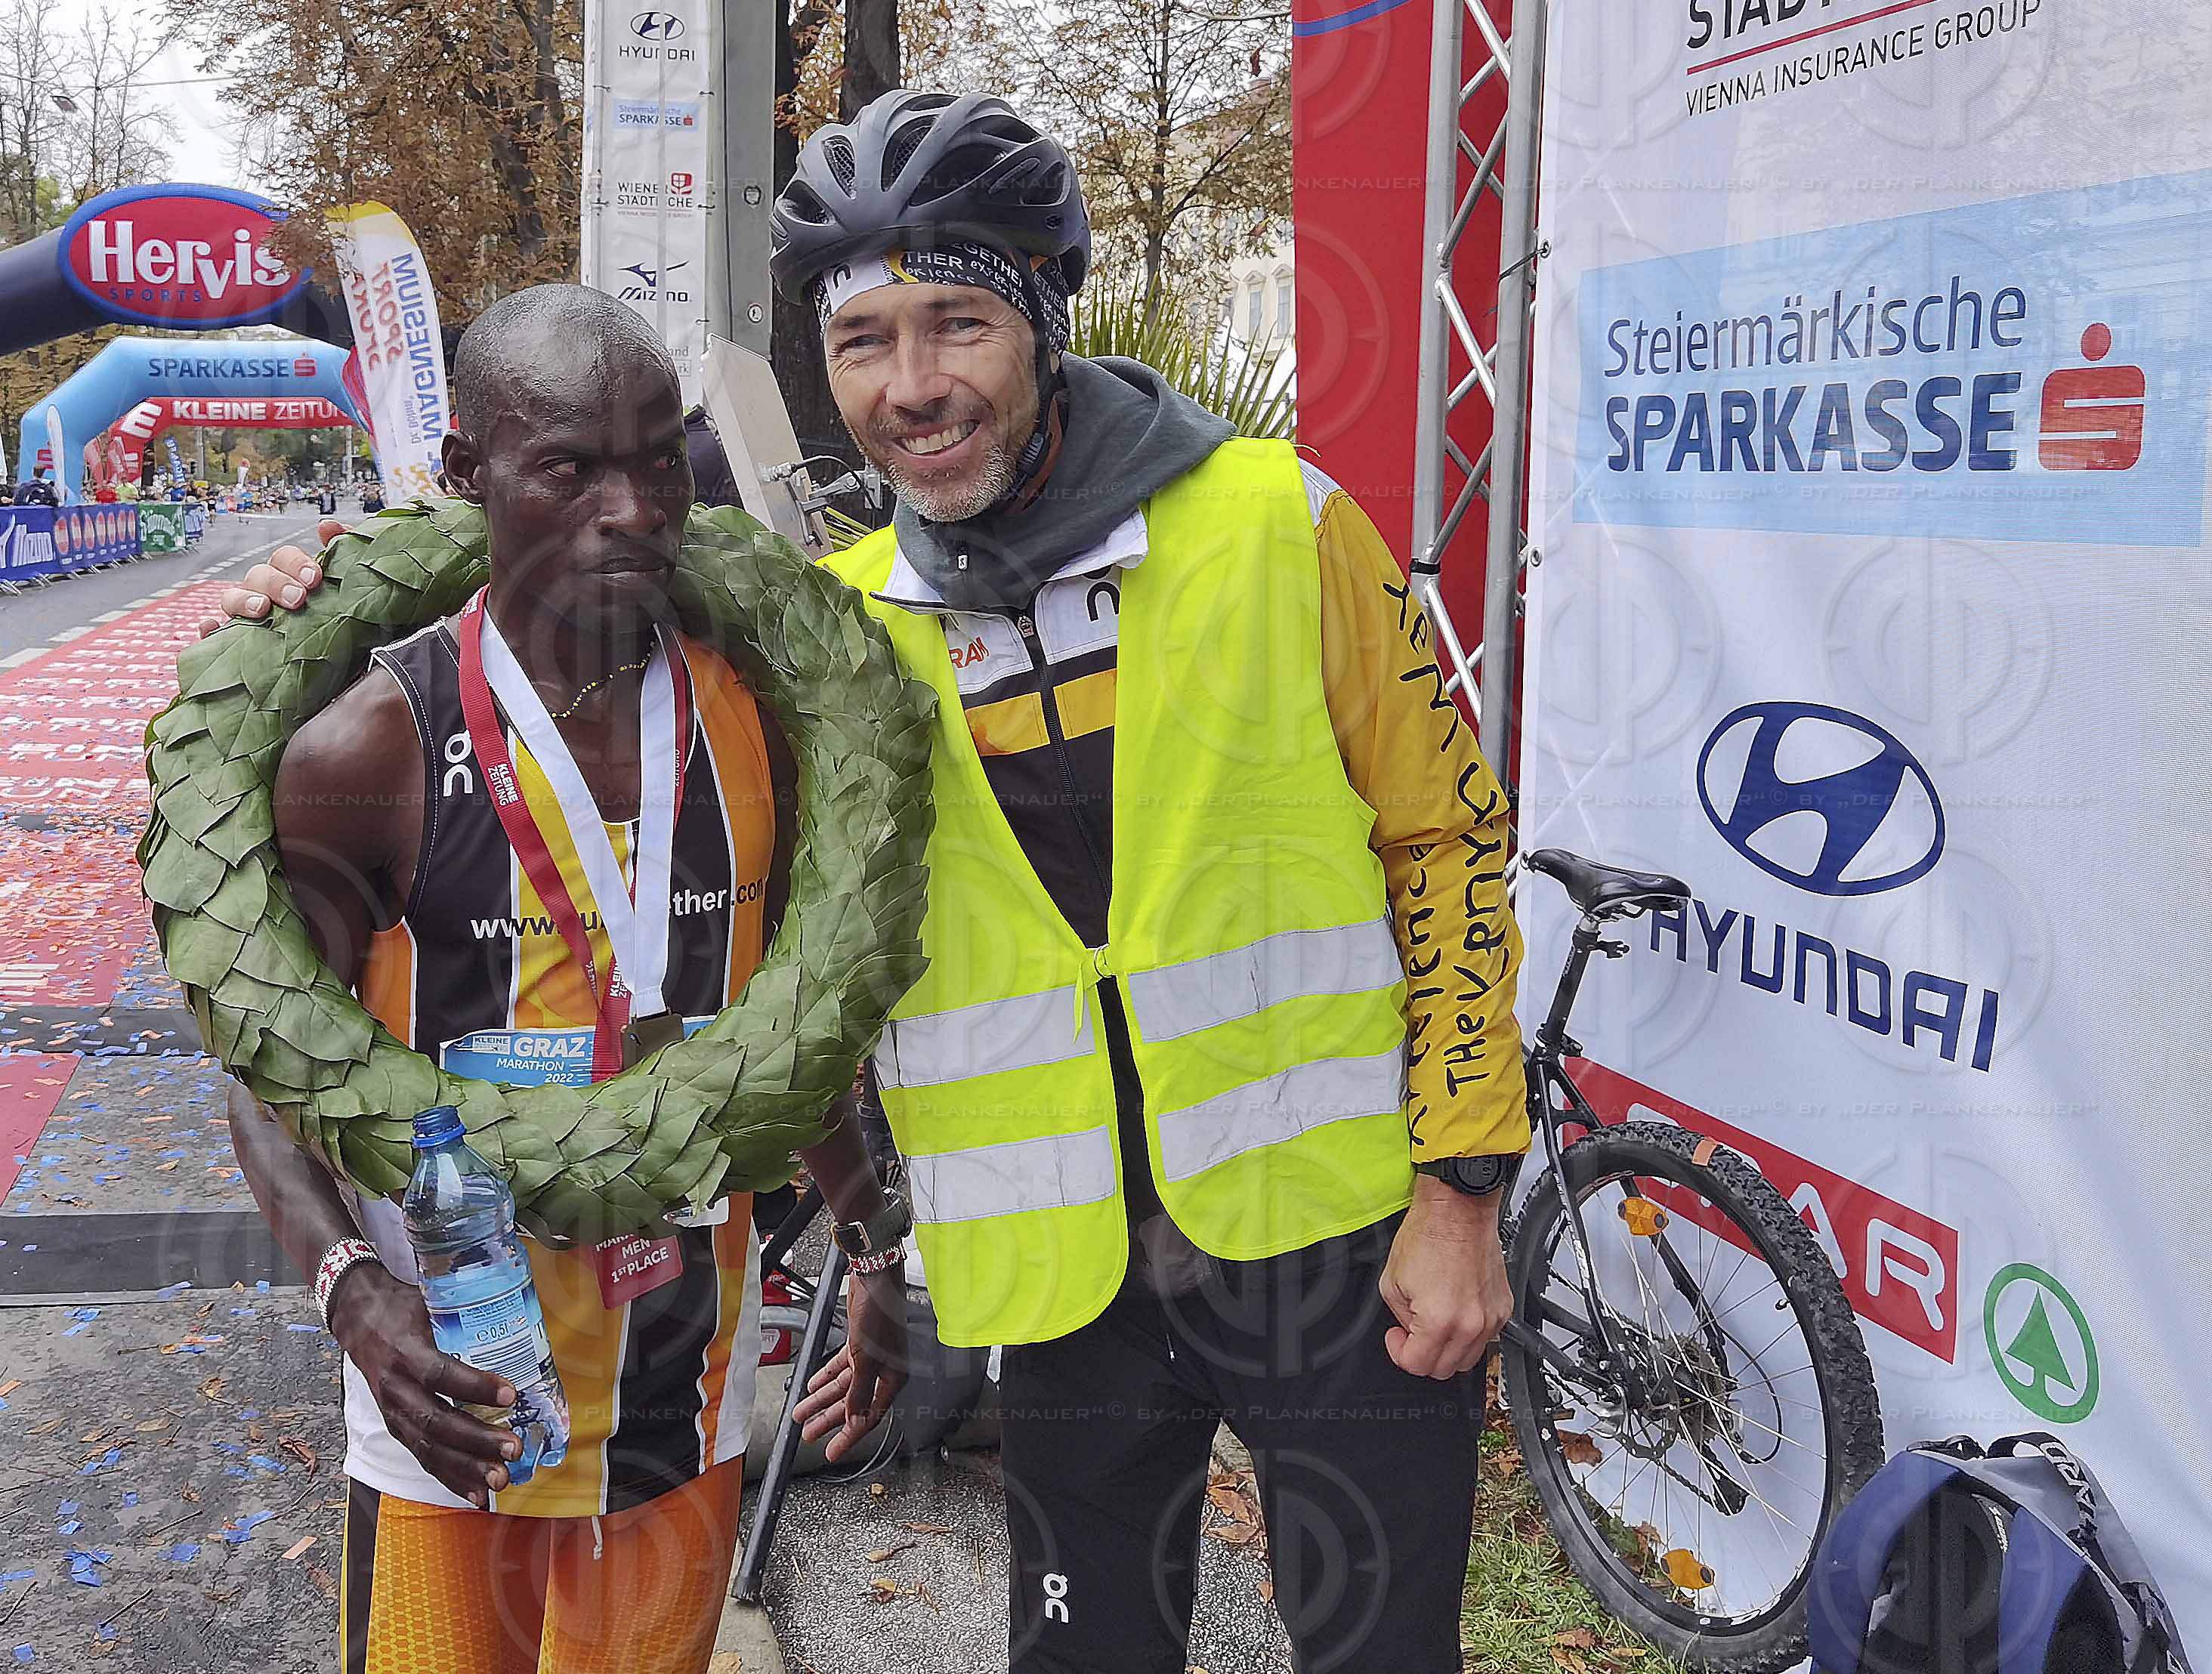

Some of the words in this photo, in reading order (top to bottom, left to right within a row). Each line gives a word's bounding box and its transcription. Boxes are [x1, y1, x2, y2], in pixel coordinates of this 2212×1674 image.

[1685, 69, 1767, 116] VIENNA
[1773, 24, 1925, 94] INSURANCE
[1934, 0, 2043, 49] GROUP
[87, 219, 292, 300] Hervis
[109, 288, 202, 302] SPORTS
[1604, 275, 2028, 378] Steiermärkische
[149, 358, 290, 378] SPARKASSE
[172, 400, 267, 421] KLEINE
[1605, 372, 2022, 471] SPARKASSE
[487, 765, 510, 806] ZEITUNG
[497, 763, 519, 803] KLEINE
[474, 1036, 508, 1045] KLEINE
[514, 1036, 586, 1058] GRAZ
[496, 1057, 565, 1071] MARATHON
[544, 1073, 574, 1083] 2022
[621, 1238, 650, 1259] MEN
